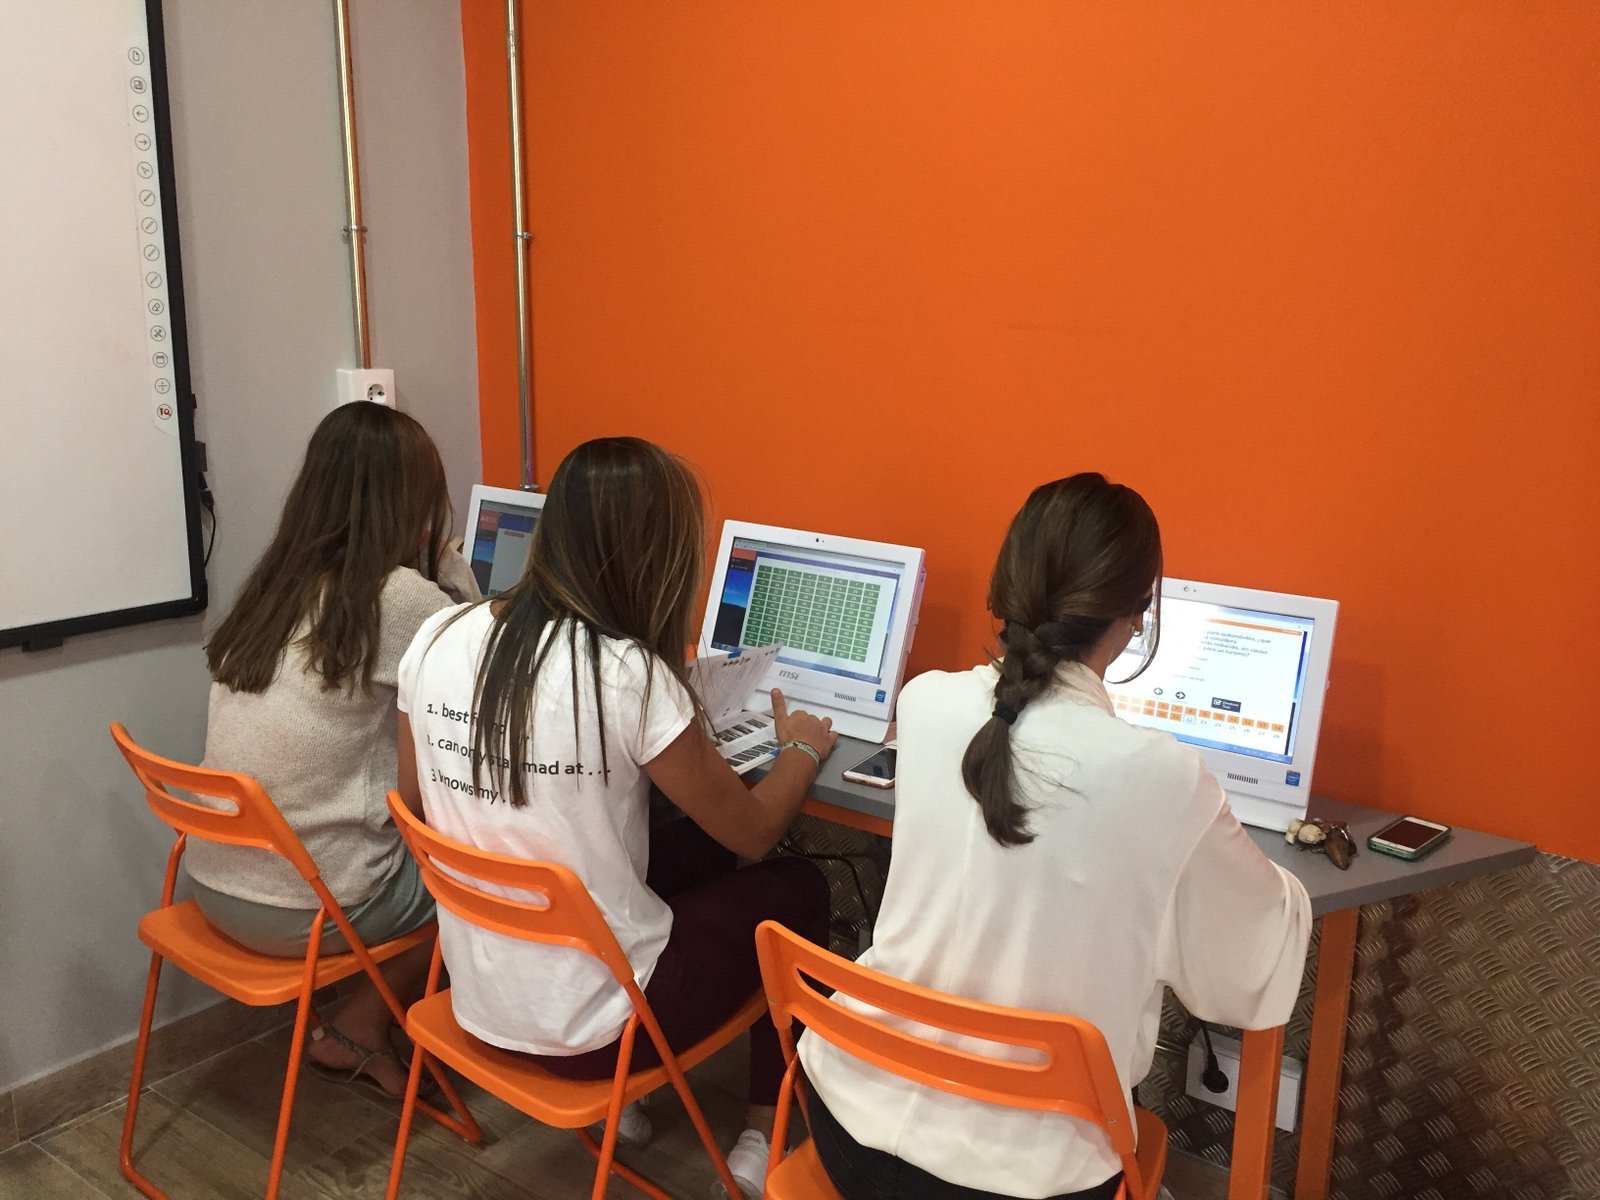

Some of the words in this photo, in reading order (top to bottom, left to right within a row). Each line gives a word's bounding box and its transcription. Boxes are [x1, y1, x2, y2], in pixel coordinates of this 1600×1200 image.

[779, 669, 800, 681] msi
[427, 704, 438, 715] 1.
[442, 703, 469, 724] best
[438, 738, 460, 753] can
[461, 746, 487, 766] ony
[523, 761, 559, 775] mad
[438, 769, 474, 796] knows
